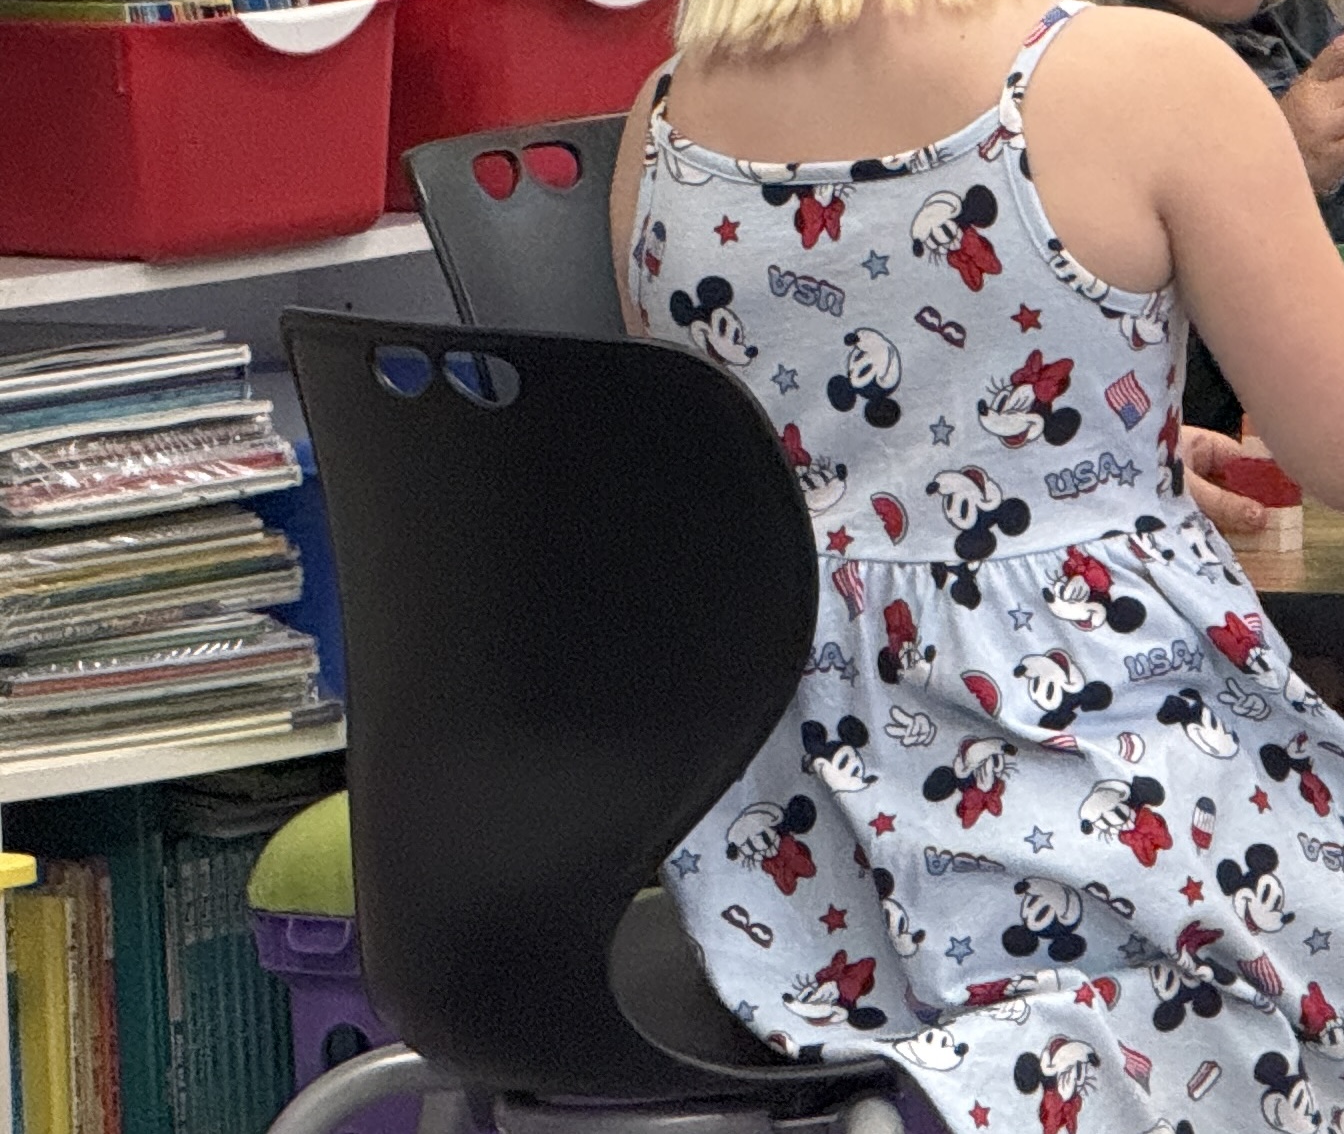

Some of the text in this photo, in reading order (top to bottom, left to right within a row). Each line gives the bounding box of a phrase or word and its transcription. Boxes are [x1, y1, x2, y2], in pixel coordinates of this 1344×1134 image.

[767, 264, 846, 318] USA
[1044, 451, 1122, 501] USA
[1123, 639, 1194, 682] USA
